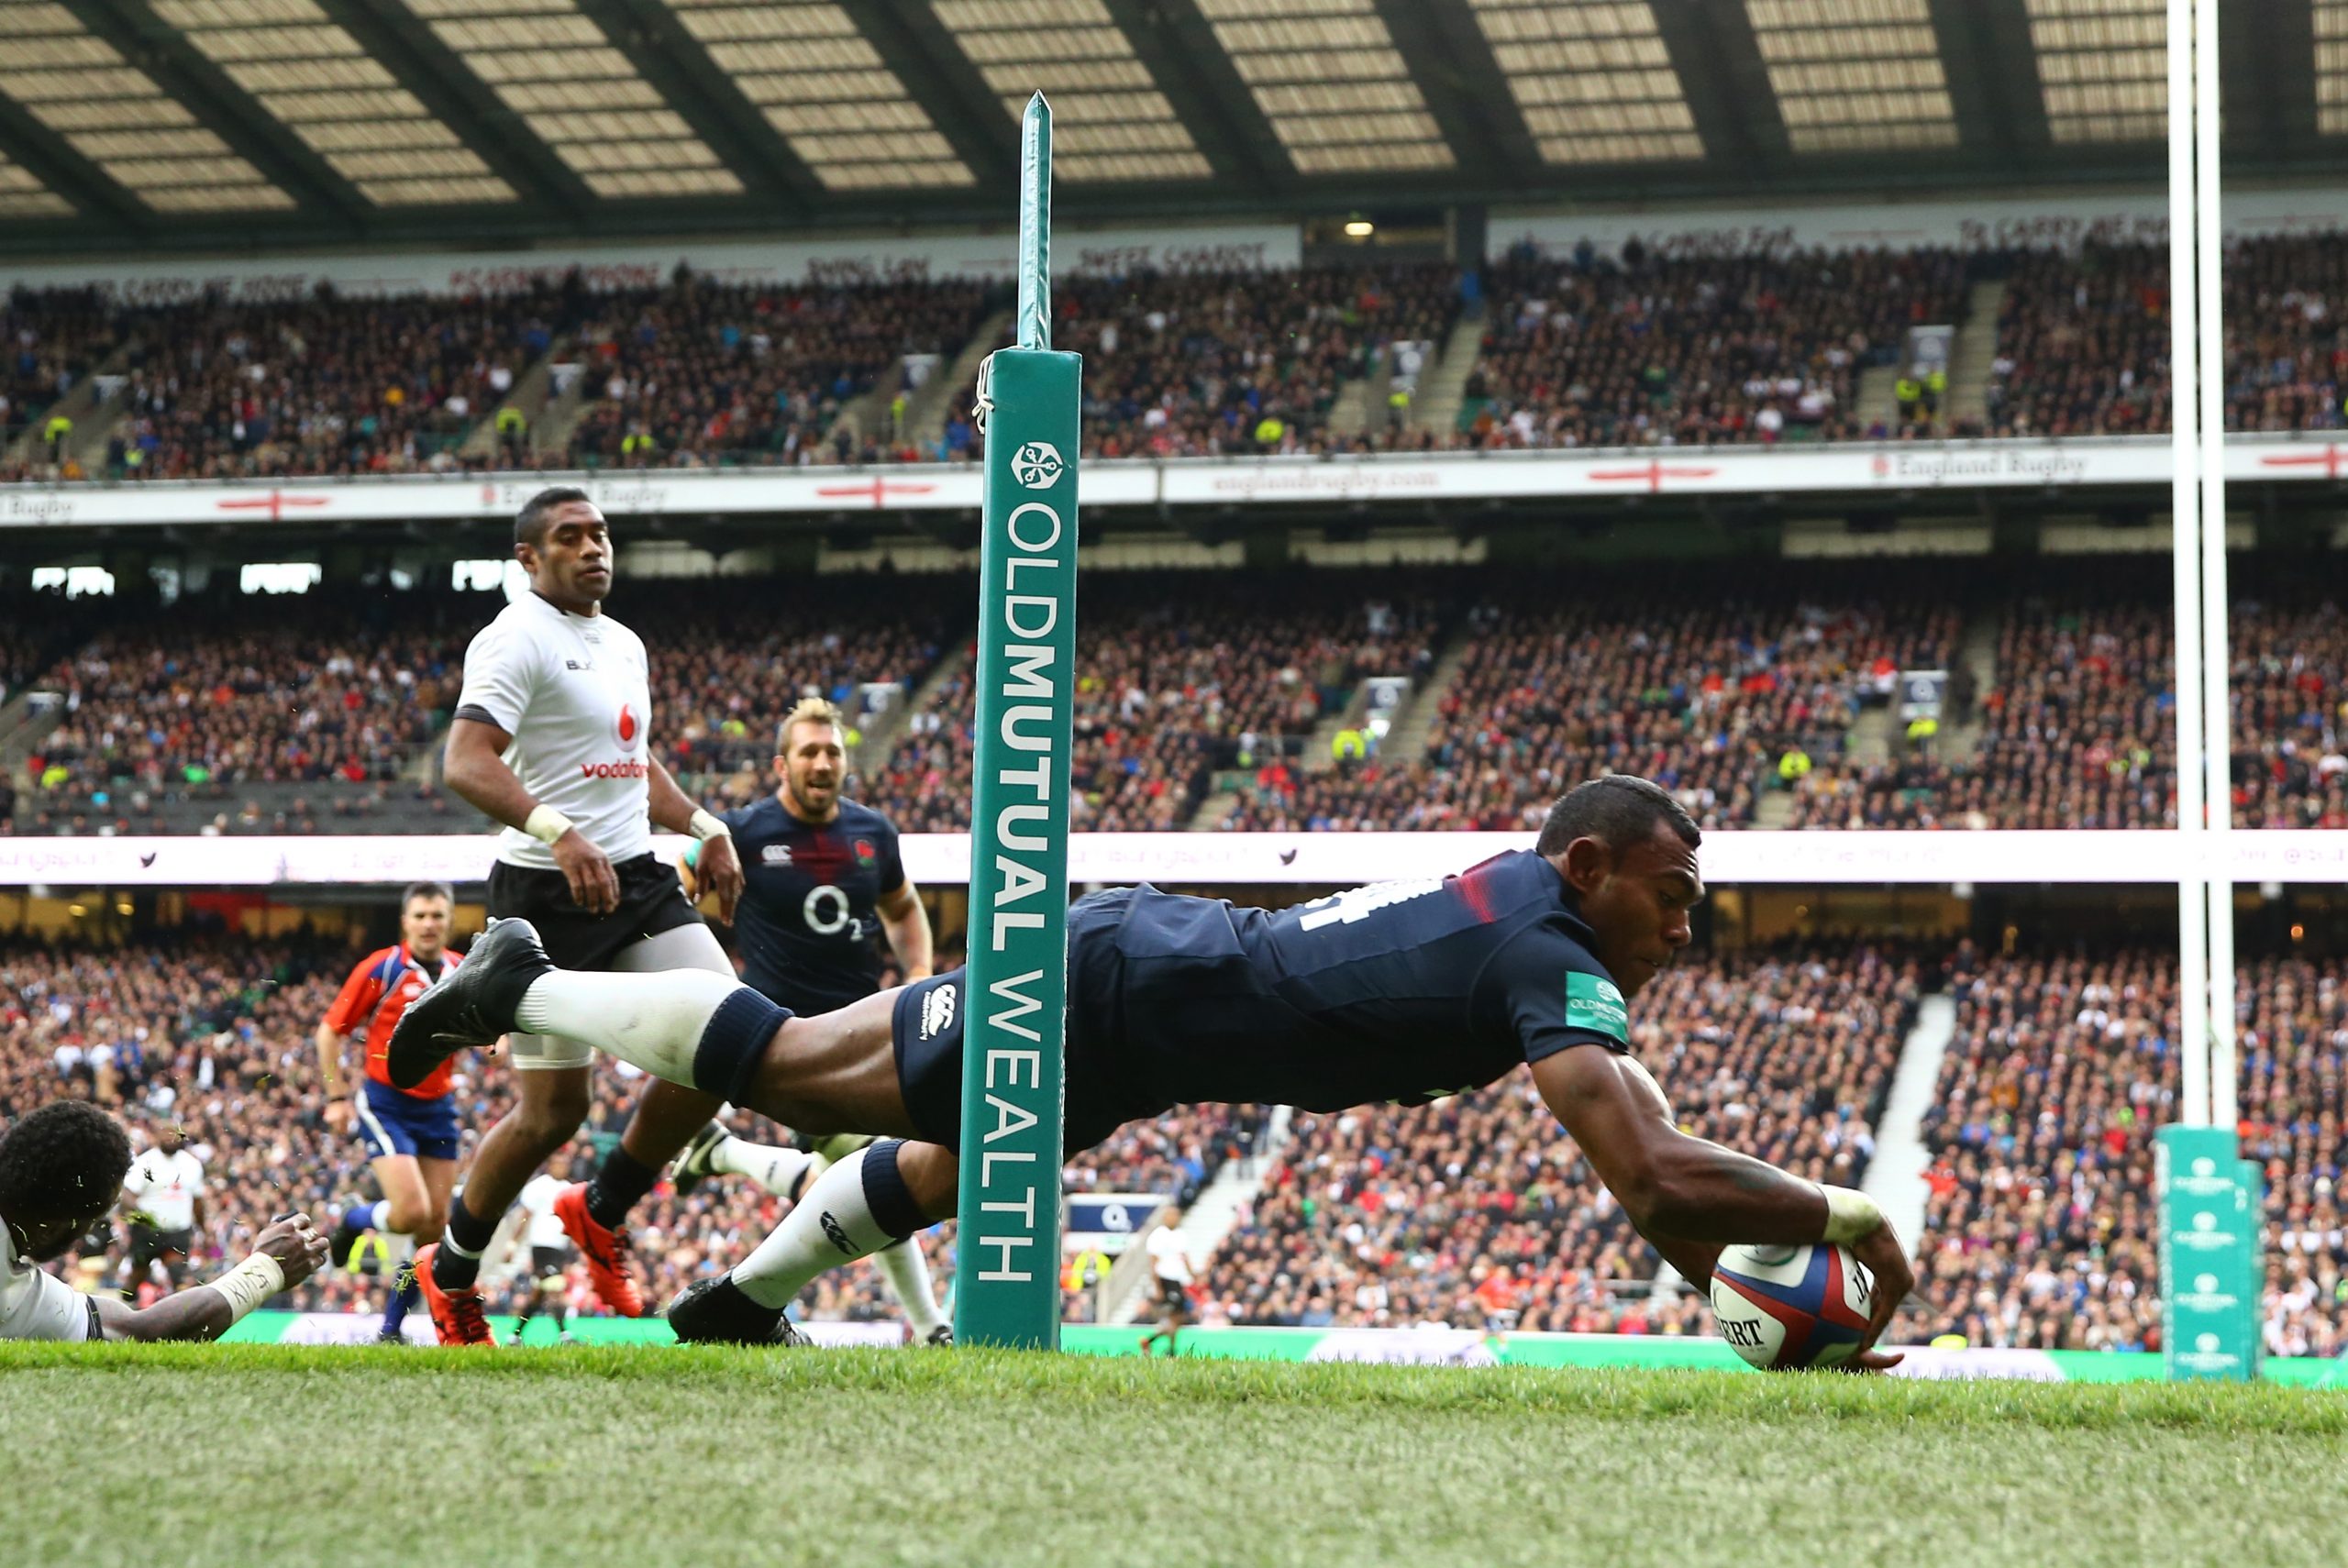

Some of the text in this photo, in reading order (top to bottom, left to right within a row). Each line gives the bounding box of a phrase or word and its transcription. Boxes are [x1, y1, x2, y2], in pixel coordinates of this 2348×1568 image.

[992, 502, 1061, 951] OLDMUTUAL
[803, 885, 864, 941] O2
[978, 968, 1044, 1282] WEALTH
[1714, 1314, 1765, 1347] ERT
